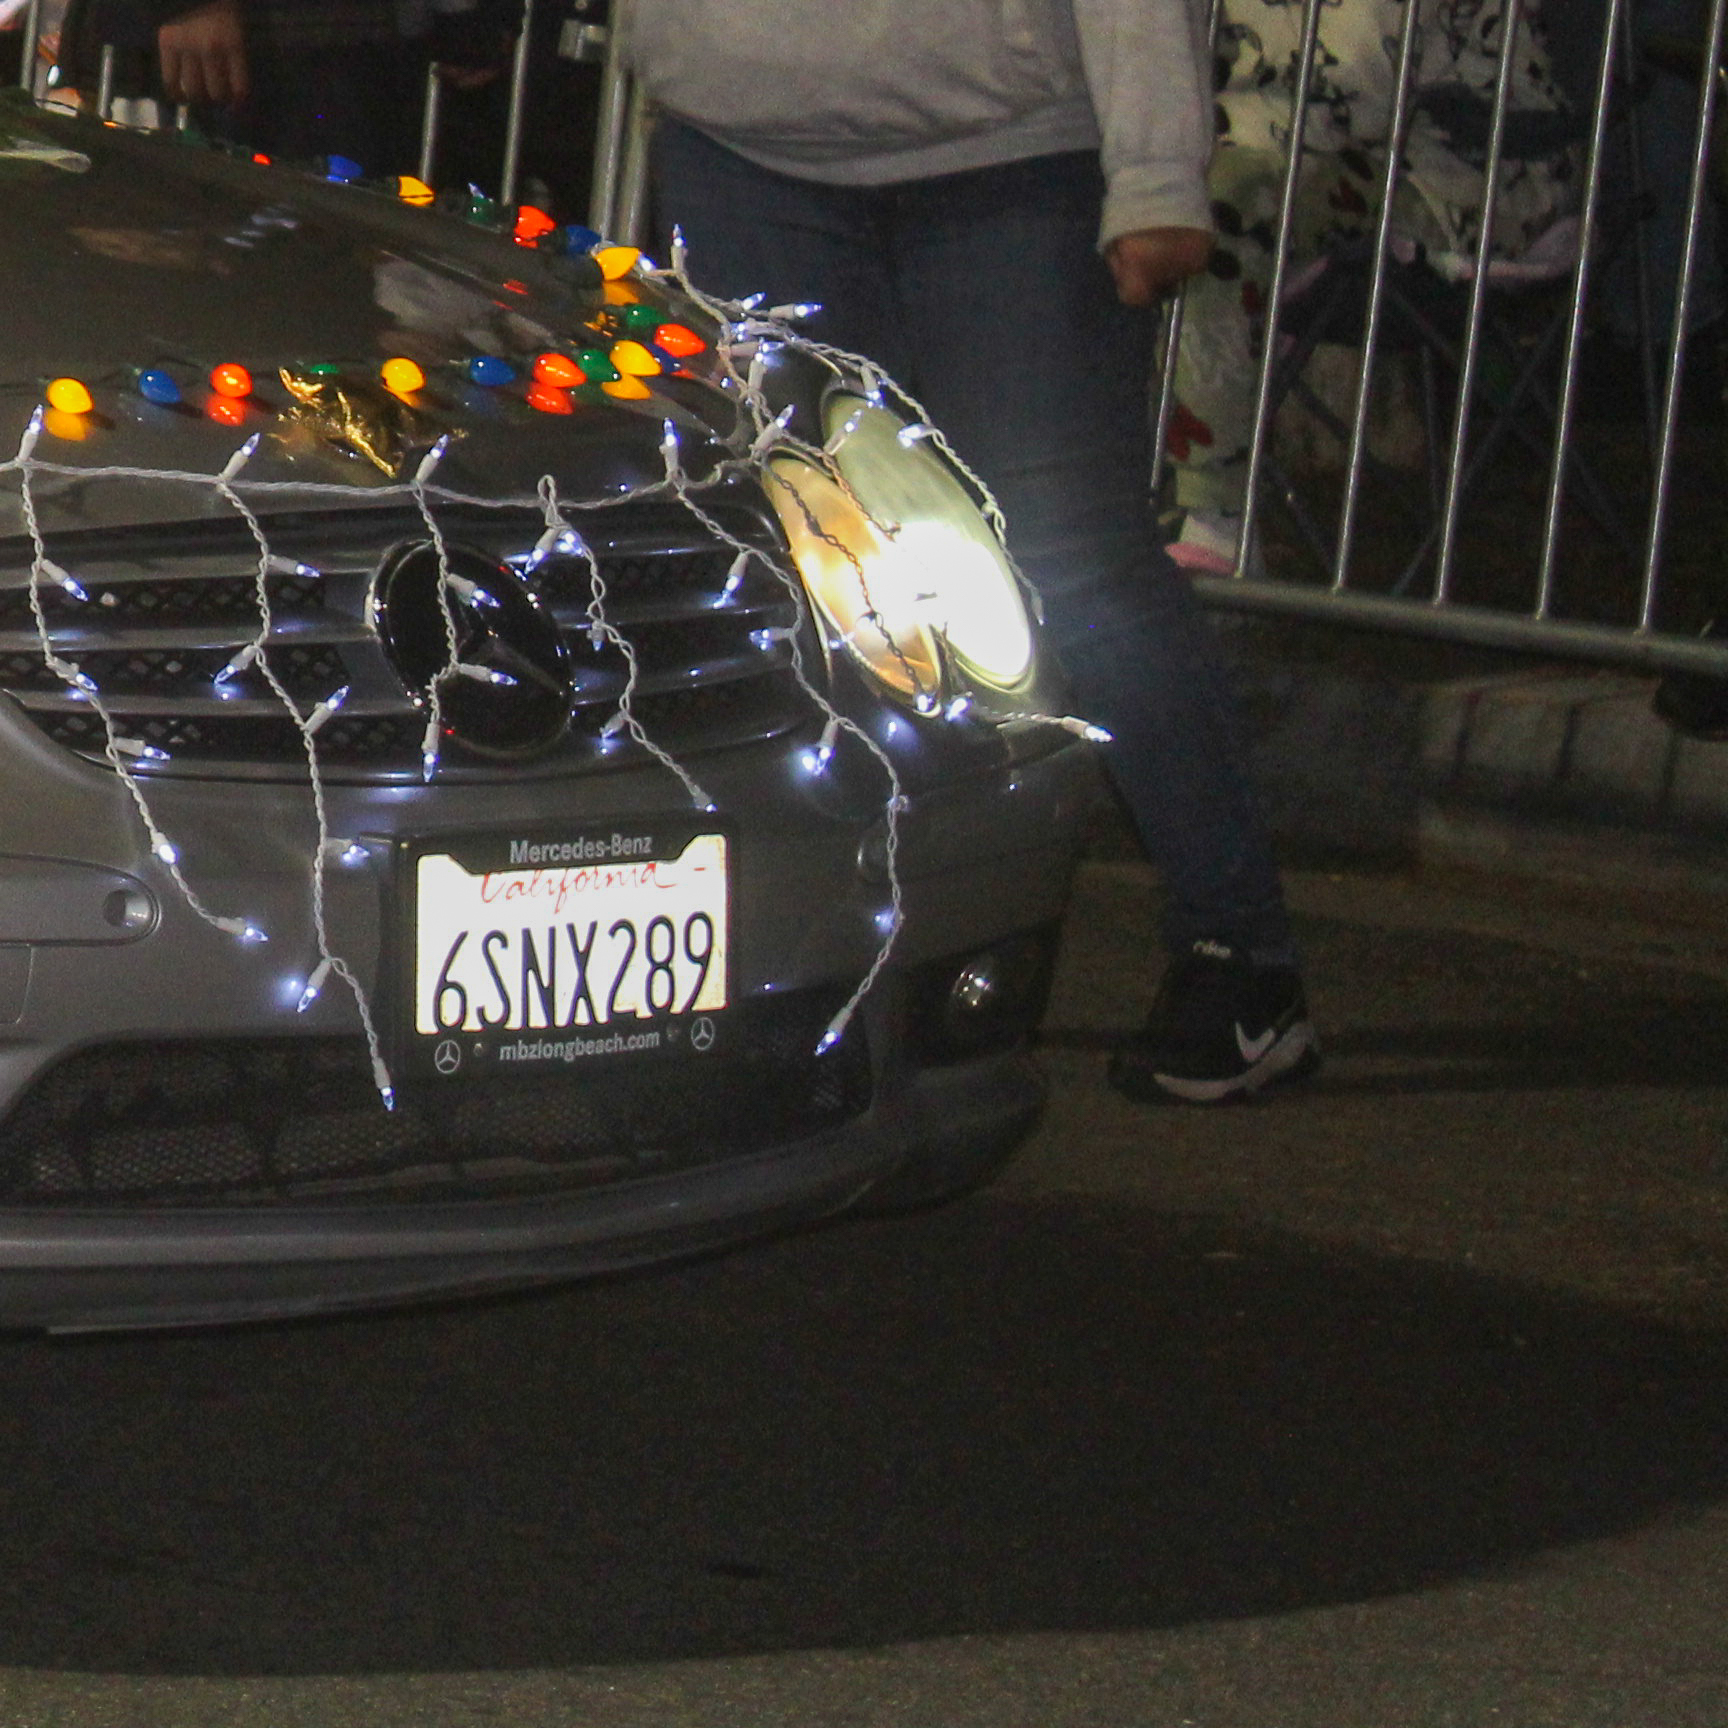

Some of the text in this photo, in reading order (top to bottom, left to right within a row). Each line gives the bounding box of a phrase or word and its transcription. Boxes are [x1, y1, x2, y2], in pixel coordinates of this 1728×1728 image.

[509, 833, 653, 865] Mercedes-Benz
[432, 911, 714, 1032] 6SNX289
[498, 1029, 661, 1063] mbzlongbeach.com
